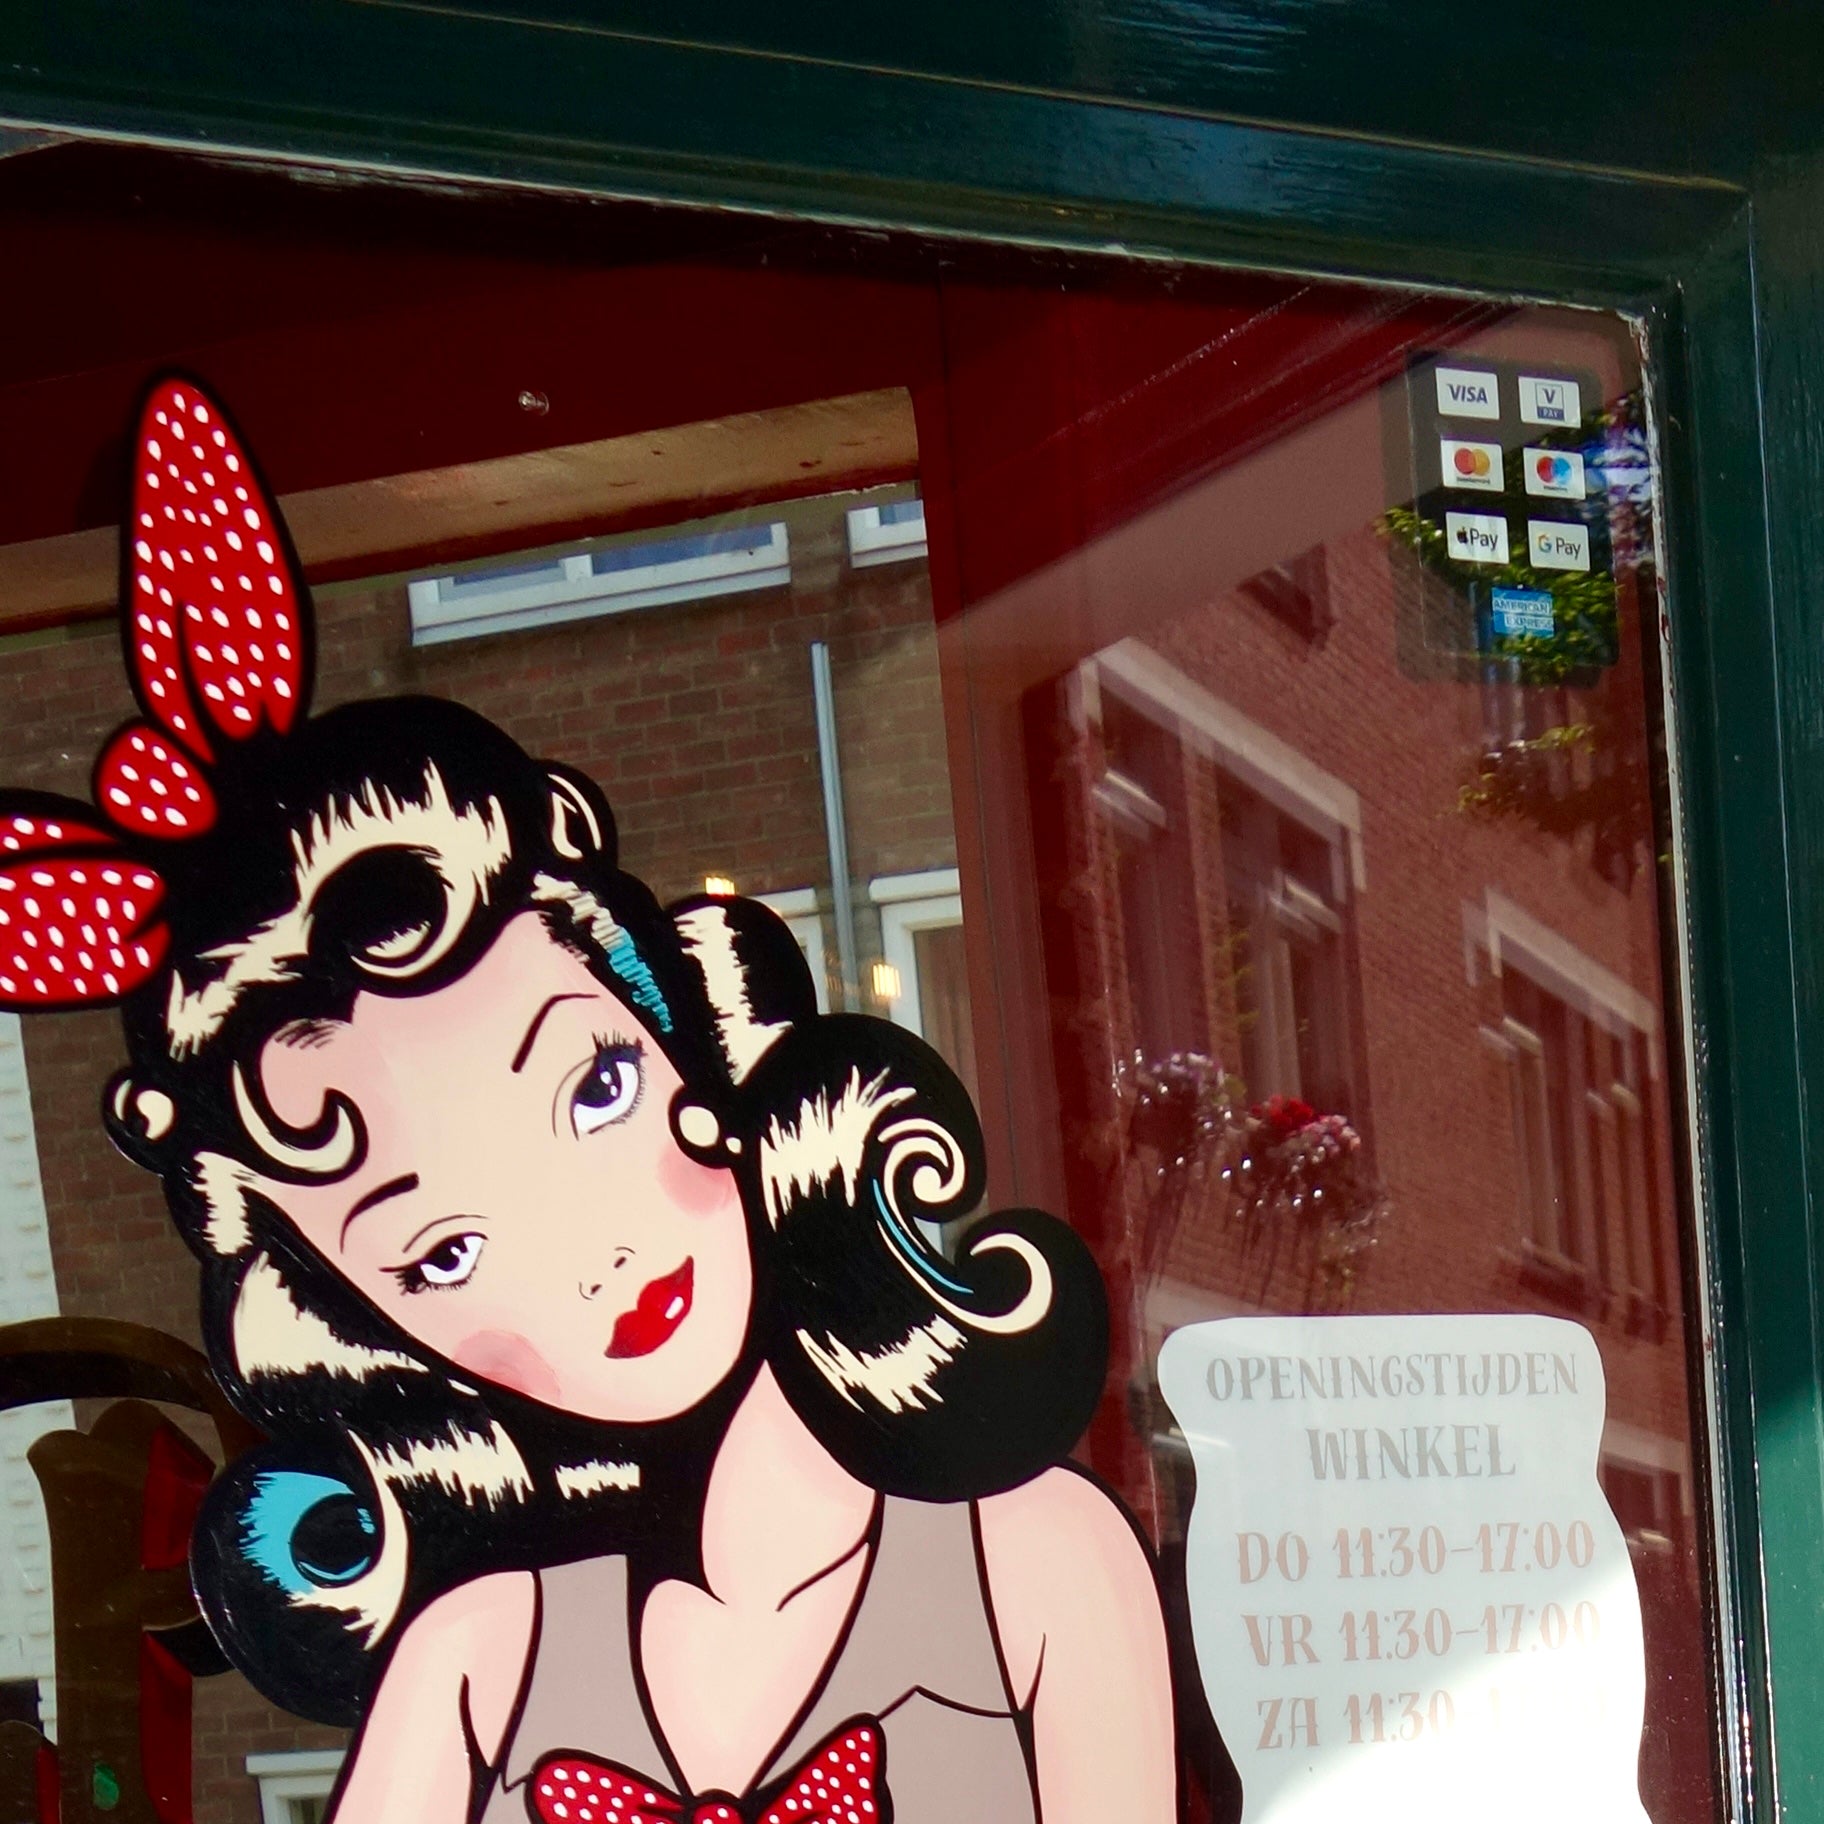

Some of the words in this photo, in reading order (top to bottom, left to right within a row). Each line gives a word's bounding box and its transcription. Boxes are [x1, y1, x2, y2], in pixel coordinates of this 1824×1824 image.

[1447, 383, 1488, 404] VISA
[1543, 388, 1555, 404] V
[1543, 407, 1559, 418] PAY
[1470, 528, 1498, 551] Pay
[1556, 536, 1581, 560] Pay
[1494, 600, 1549, 613] AMERICAN
[1205, 1353, 1579, 1401] OPENINGSTIJDEN
[1306, 1424, 1516, 1480] WINKEL
[1235, 1531, 1312, 1584] DO
[1241, 1613, 1320, 1667] VR
[1256, 1696, 1320, 1751] ZA
